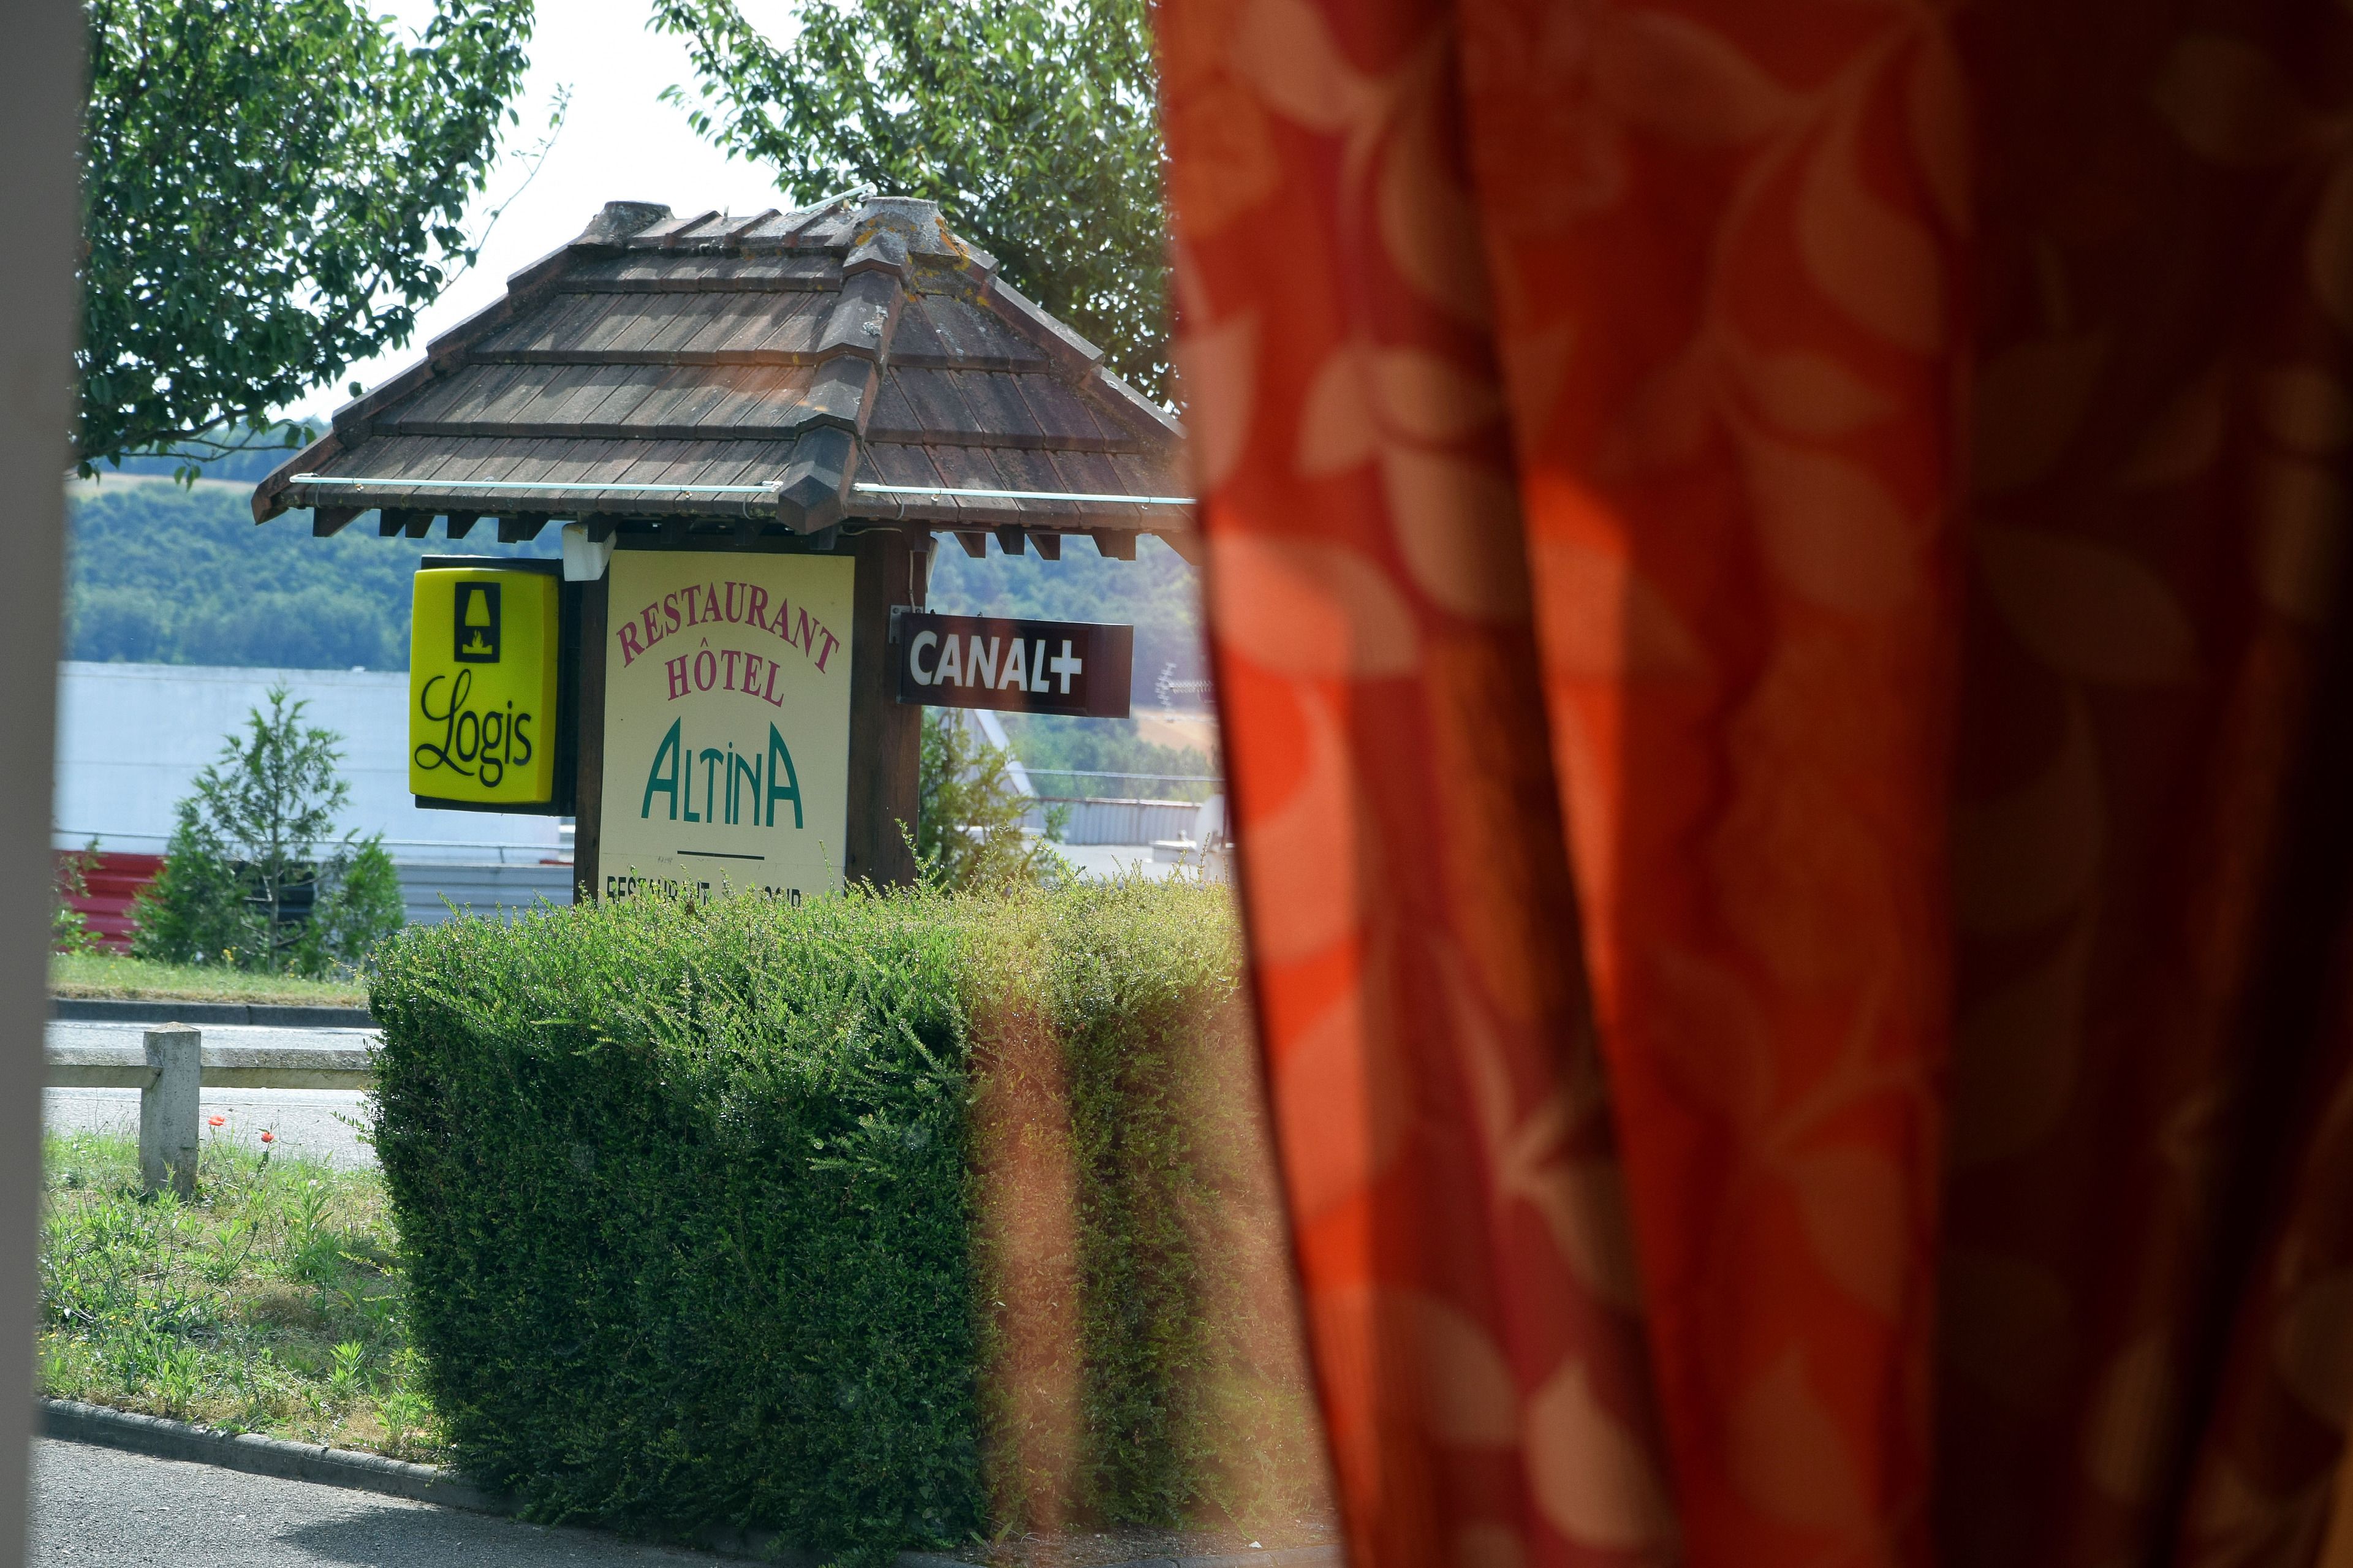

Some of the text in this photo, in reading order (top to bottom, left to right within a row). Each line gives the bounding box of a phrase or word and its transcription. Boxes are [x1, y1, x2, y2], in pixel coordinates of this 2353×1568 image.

[615, 581, 841, 675] RESTAURANT
[910, 630, 1082, 695] CANAL+
[664, 637, 784, 708] HÔTEL
[414, 668, 532, 788] Logis
